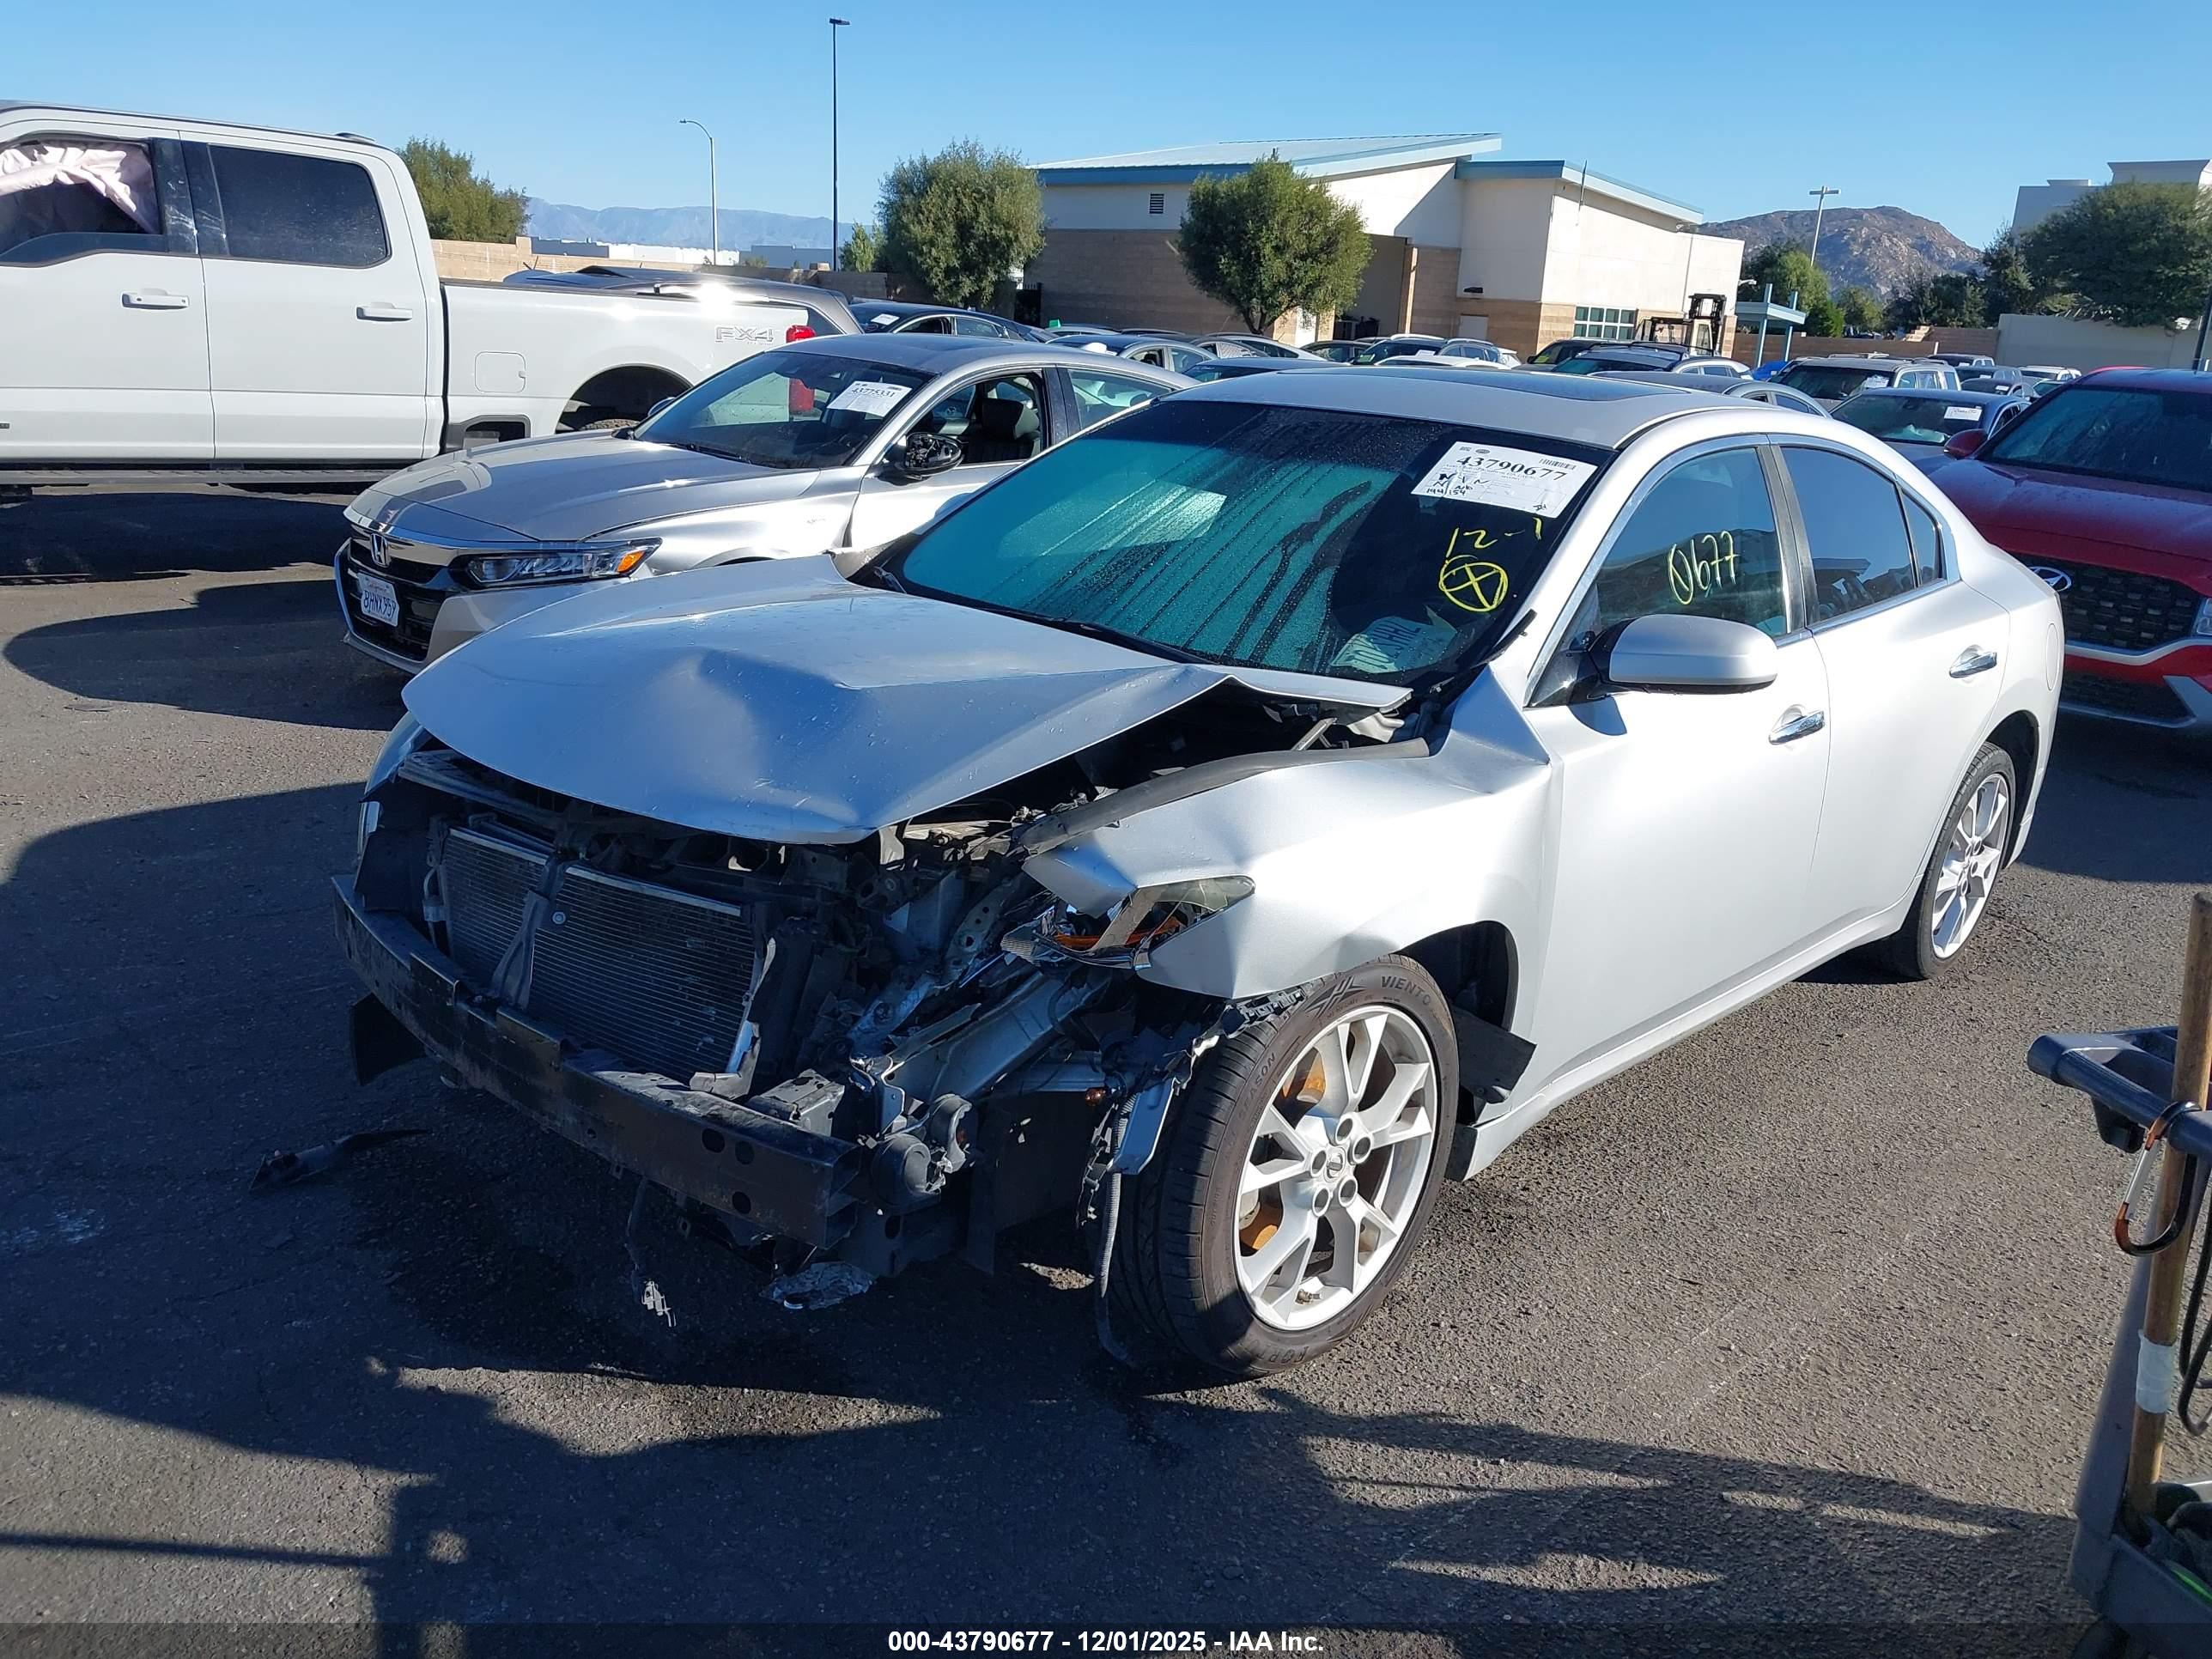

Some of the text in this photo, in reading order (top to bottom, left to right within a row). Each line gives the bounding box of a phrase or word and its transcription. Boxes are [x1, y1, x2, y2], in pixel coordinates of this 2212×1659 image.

[715, 325, 774, 342] FX4
[1456, 456, 1568, 480] 43790677
[1668, 530, 1740, 605] 0677
[1381, 975, 1431, 1006] VIENTO
